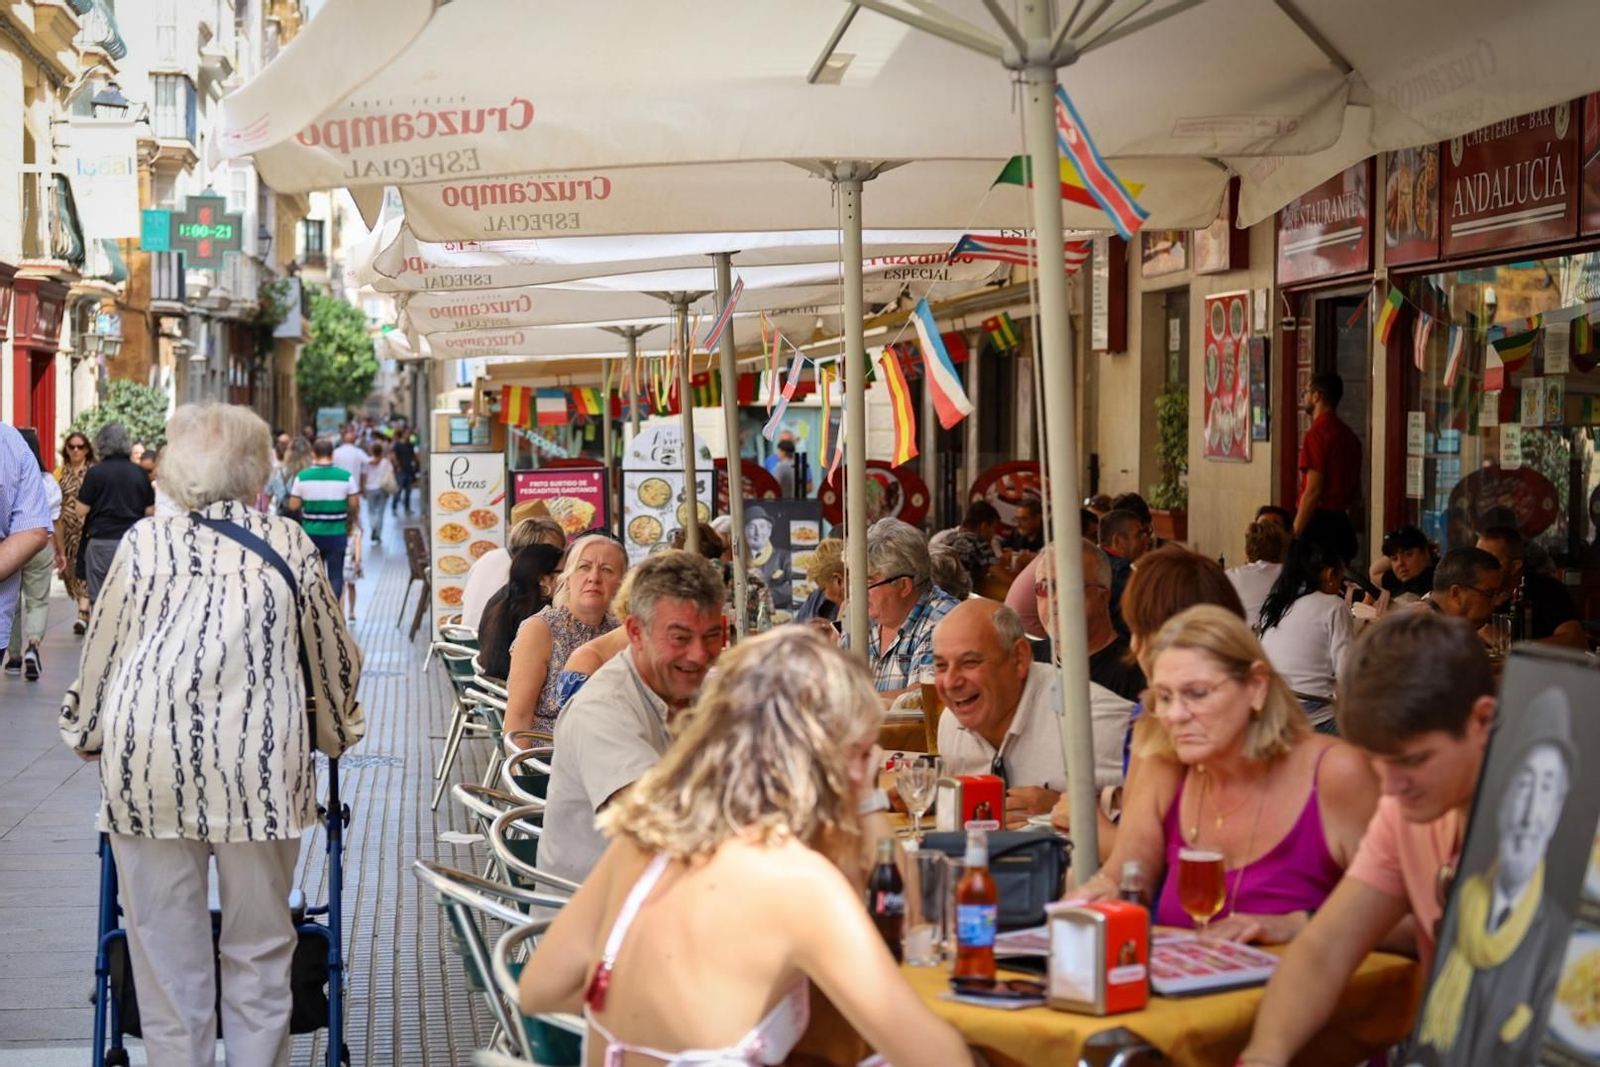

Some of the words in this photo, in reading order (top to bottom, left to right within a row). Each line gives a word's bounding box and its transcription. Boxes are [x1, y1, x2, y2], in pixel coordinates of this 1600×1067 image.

[1452, 142, 1566, 218] ANDALUCÍA
[884, 268, 952, 281] ESPECIAL
[445, 456, 487, 489] Pizzas
